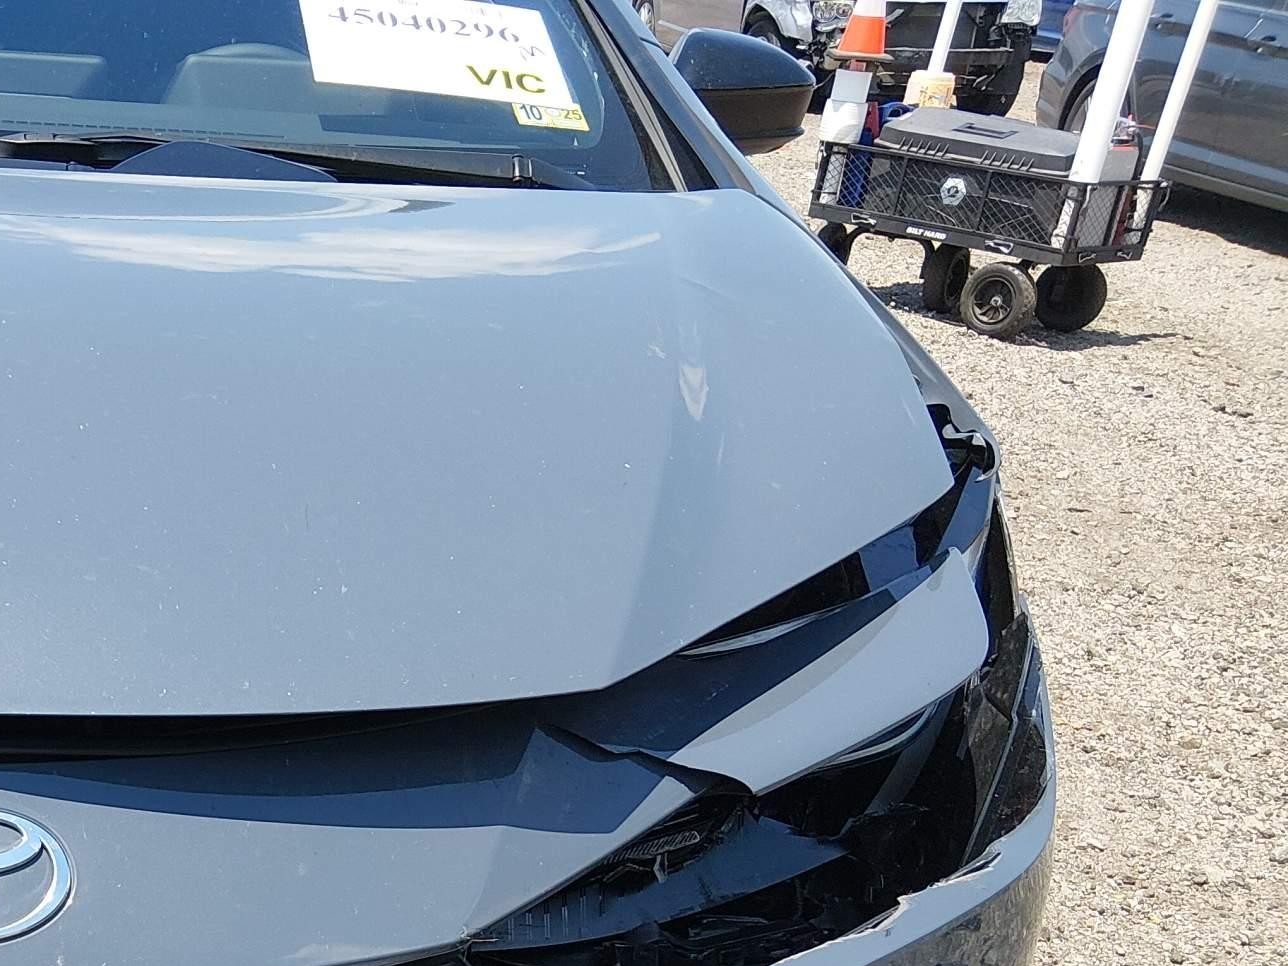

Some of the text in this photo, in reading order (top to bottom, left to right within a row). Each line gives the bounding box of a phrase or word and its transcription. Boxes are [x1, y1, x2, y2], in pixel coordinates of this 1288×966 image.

[328, 6, 520, 42] 45040296
[466, 64, 546, 94] VIC
[519, 103, 582, 121] 10 25
